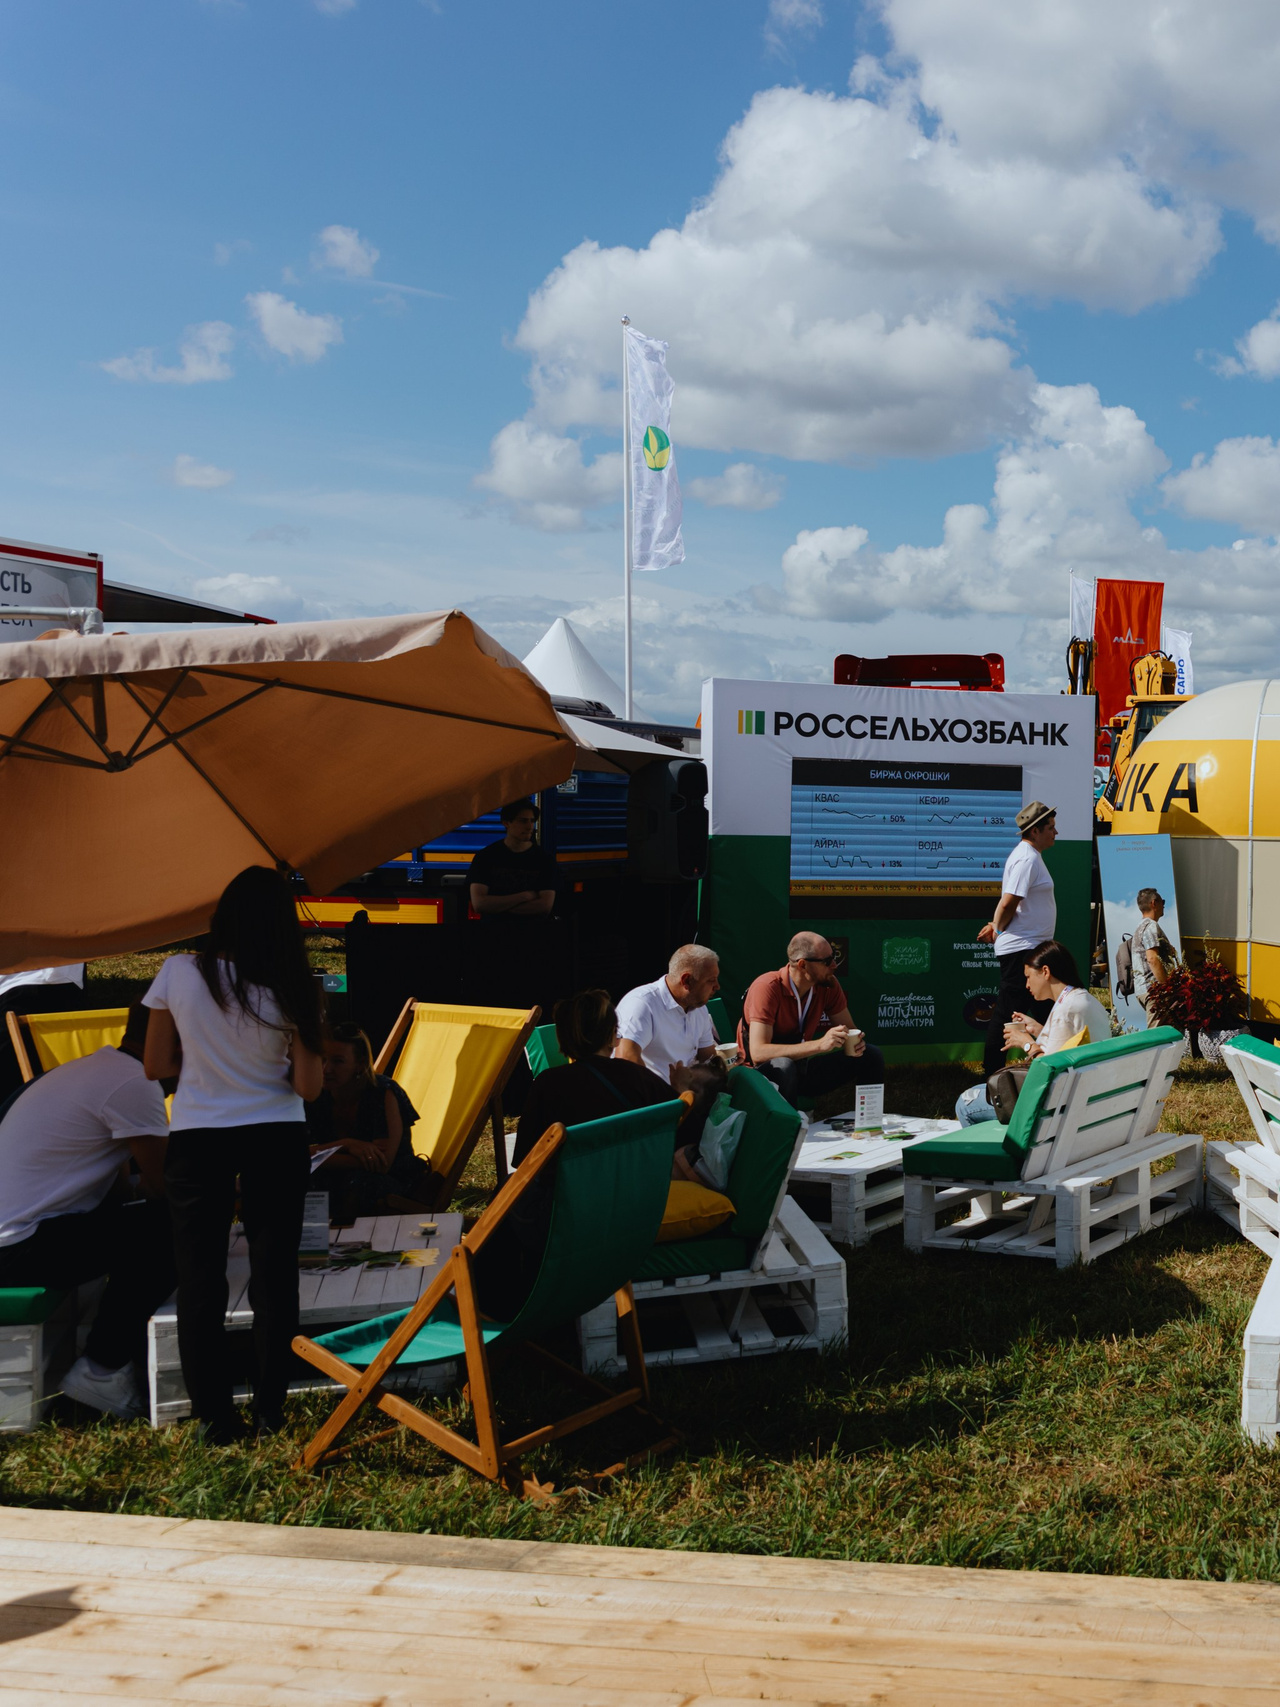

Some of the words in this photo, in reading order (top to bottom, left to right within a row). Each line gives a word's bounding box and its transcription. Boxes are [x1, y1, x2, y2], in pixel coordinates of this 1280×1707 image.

[774, 711, 1070, 747] РОССЕЛЬХОЗБАНК
[869, 769, 902, 780] БИРЖА
[904, 771, 951, 781] ОКРОШКИ
[814, 793, 840, 803] КВАС
[919, 796, 950, 806] КЕФИР
[890, 815, 906, 823] 50%
[990, 817, 1005, 825] 33%
[814, 838, 846, 849] АЙРАН
[918, 841, 944, 852] ВОДА
[889, 860, 902, 868] 13%
[877, 1018, 934, 1028] МАНУФАКТУРА
